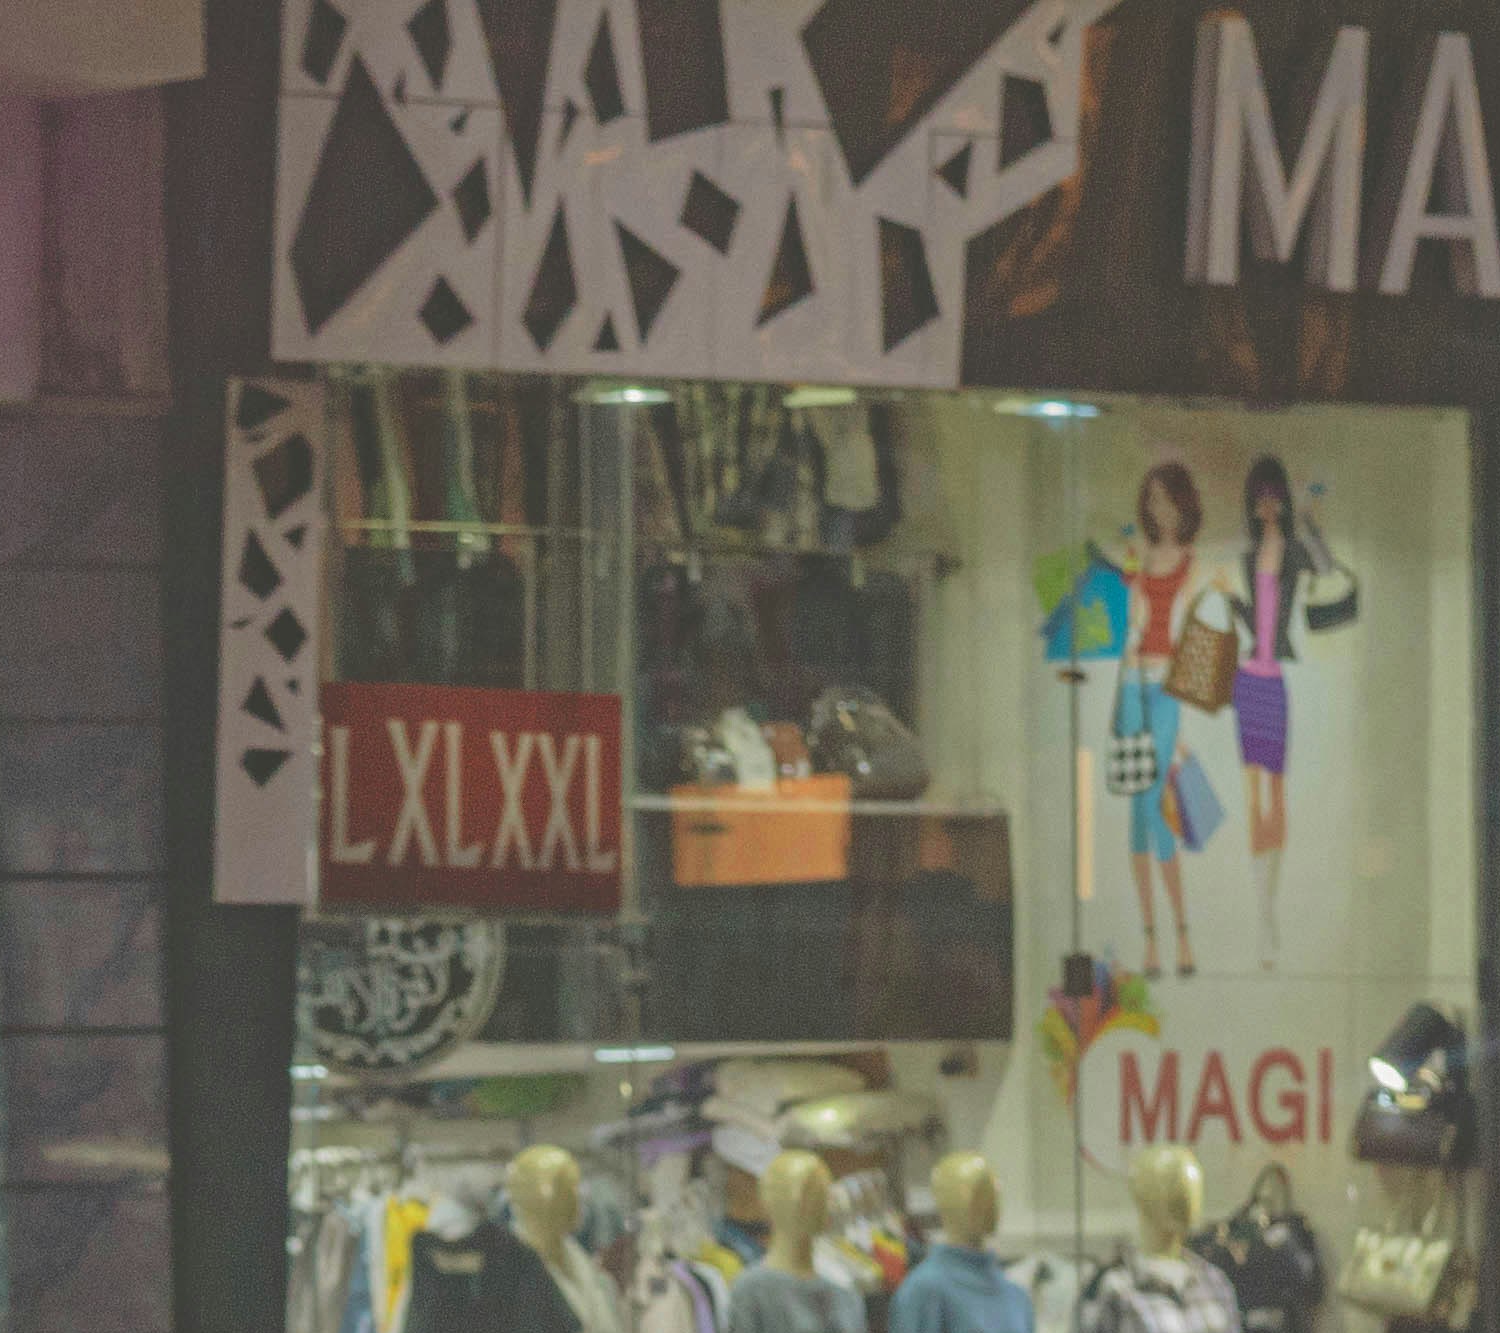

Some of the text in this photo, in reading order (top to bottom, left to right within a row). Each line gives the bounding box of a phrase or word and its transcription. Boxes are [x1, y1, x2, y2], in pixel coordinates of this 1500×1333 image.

[331, 721, 618, 873] L XL XXL
[1119, 1048, 1333, 1146] MAGI
